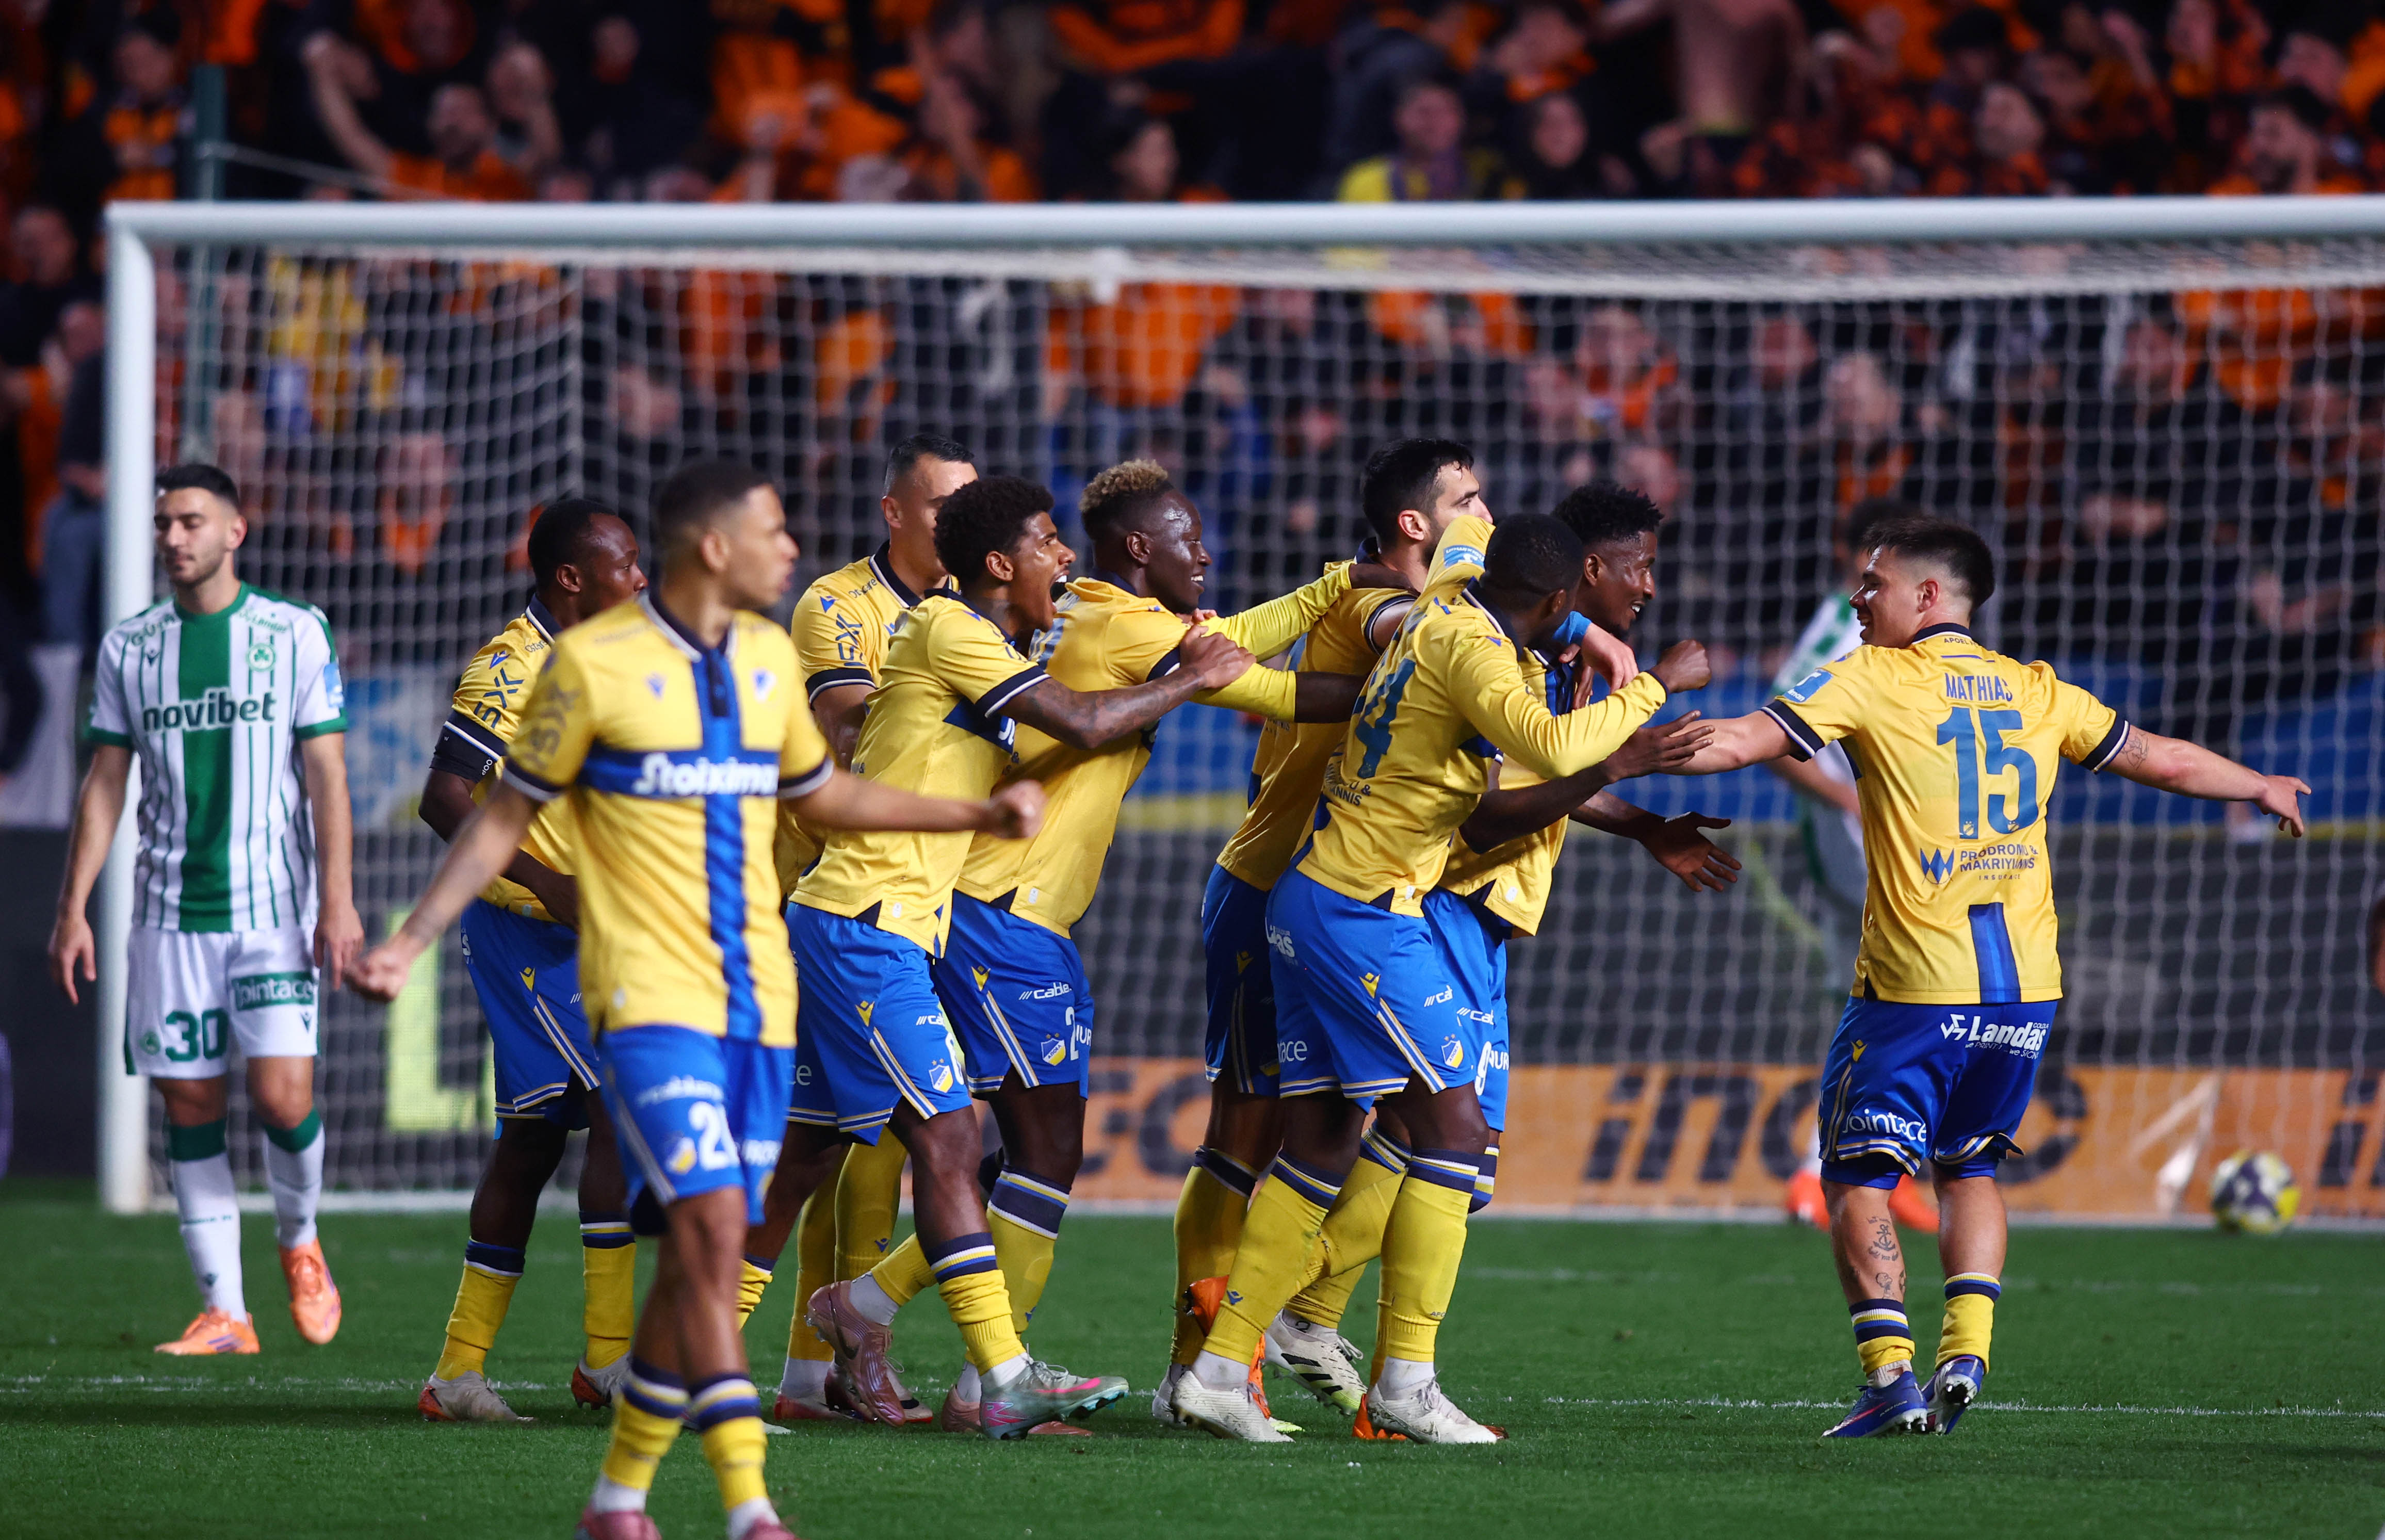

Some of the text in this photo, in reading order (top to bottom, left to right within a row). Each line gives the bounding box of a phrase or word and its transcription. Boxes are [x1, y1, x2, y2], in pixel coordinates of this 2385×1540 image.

[143, 691, 277, 732] novibet
[1937, 706, 2039, 840] 15
[166, 1007, 229, 1061] 30
[1968, 1016, 2046, 1051] Landas
